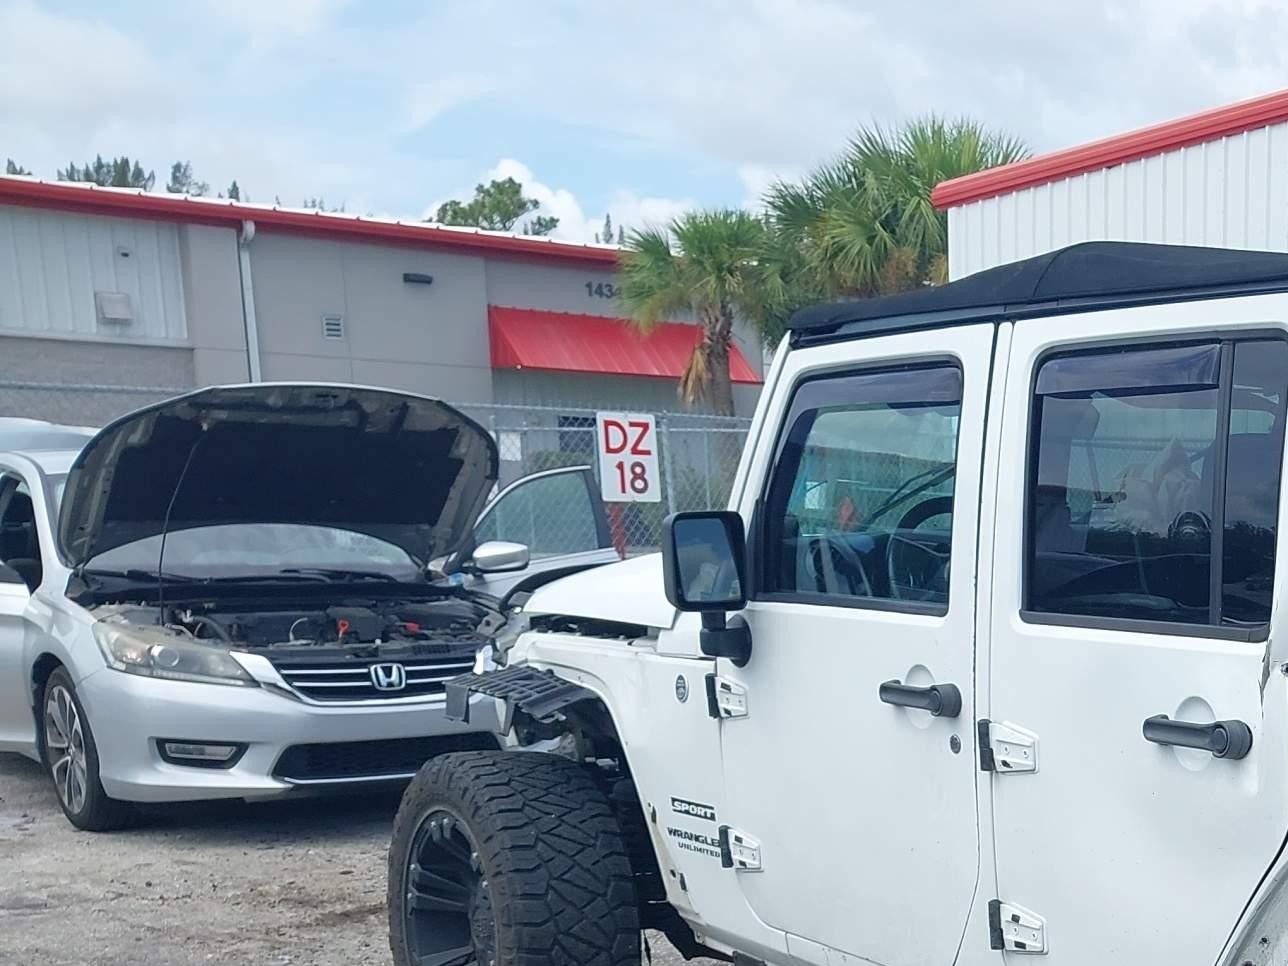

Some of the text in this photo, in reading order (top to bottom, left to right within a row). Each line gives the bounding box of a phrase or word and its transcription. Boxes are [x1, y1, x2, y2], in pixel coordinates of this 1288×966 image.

[584, 281, 621, 299] 143
[603, 419, 652, 456] DZ
[615, 461, 649, 494] 18
[673, 800, 716, 820] SPORT
[667, 826, 720, 848] WRANGLE
